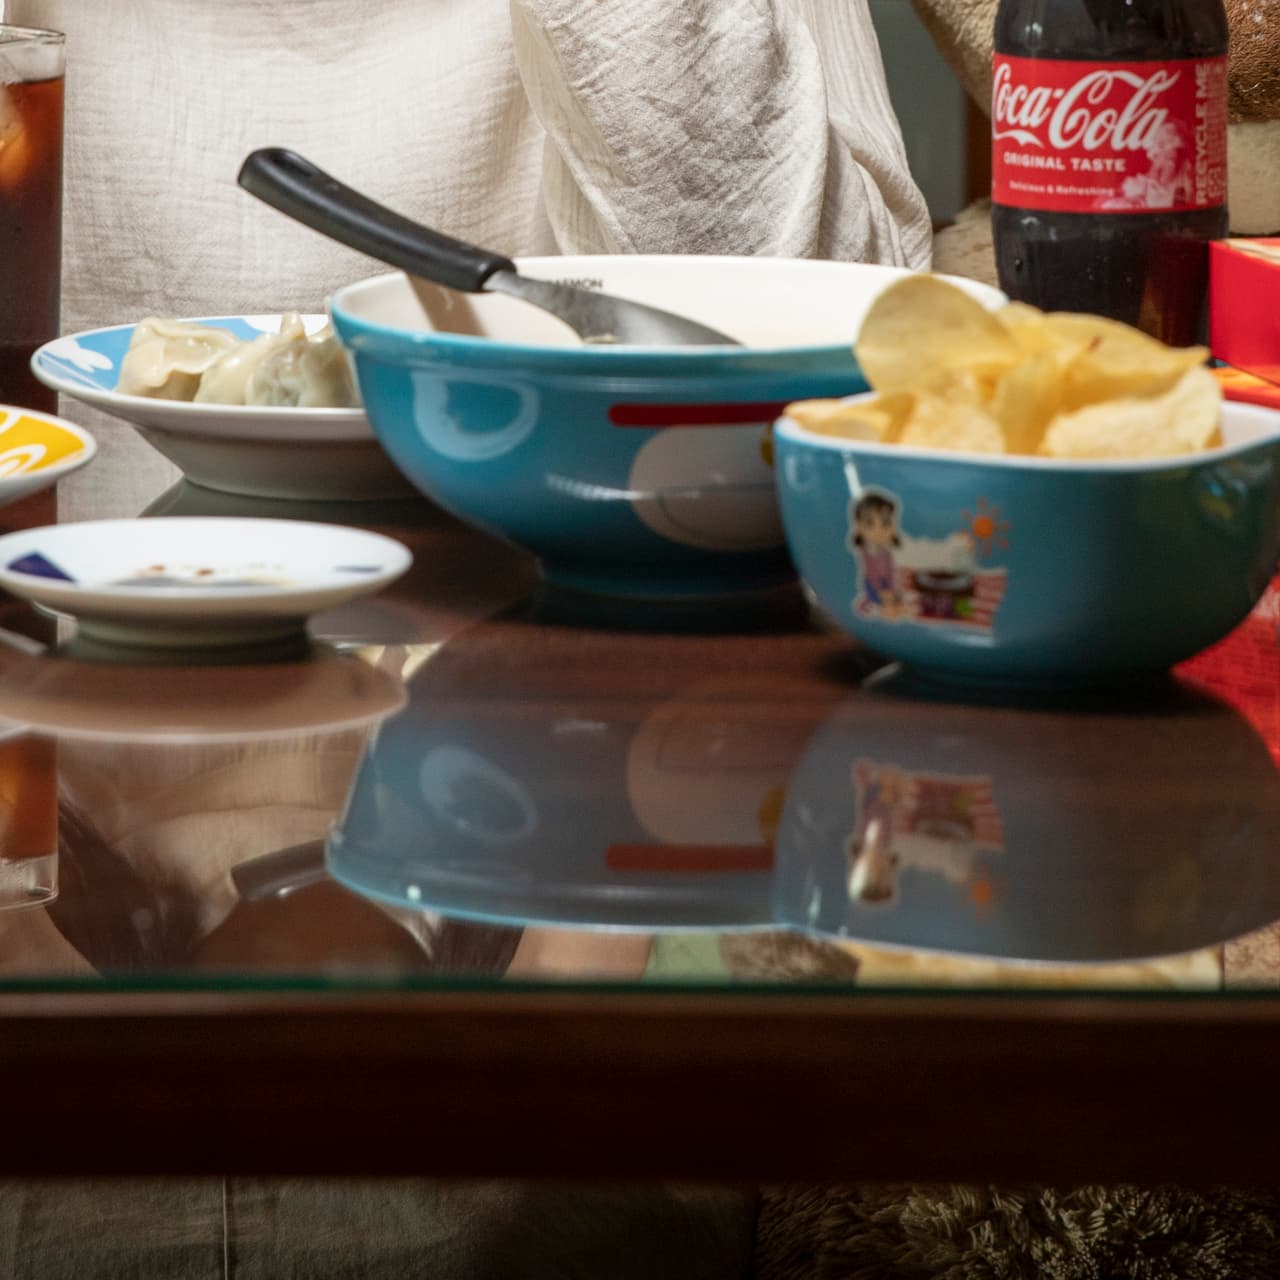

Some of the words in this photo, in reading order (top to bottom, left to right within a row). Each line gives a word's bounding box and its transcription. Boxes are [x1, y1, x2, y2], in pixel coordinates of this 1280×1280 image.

[992, 62, 1181, 150] Coca-Cola
[1194, 63, 1210, 99] ME
[1004, 151, 1067, 171] ORIGINAL
[1071, 157, 1128, 173] TASTE
[1194, 103, 1209, 204] RECYCLE
